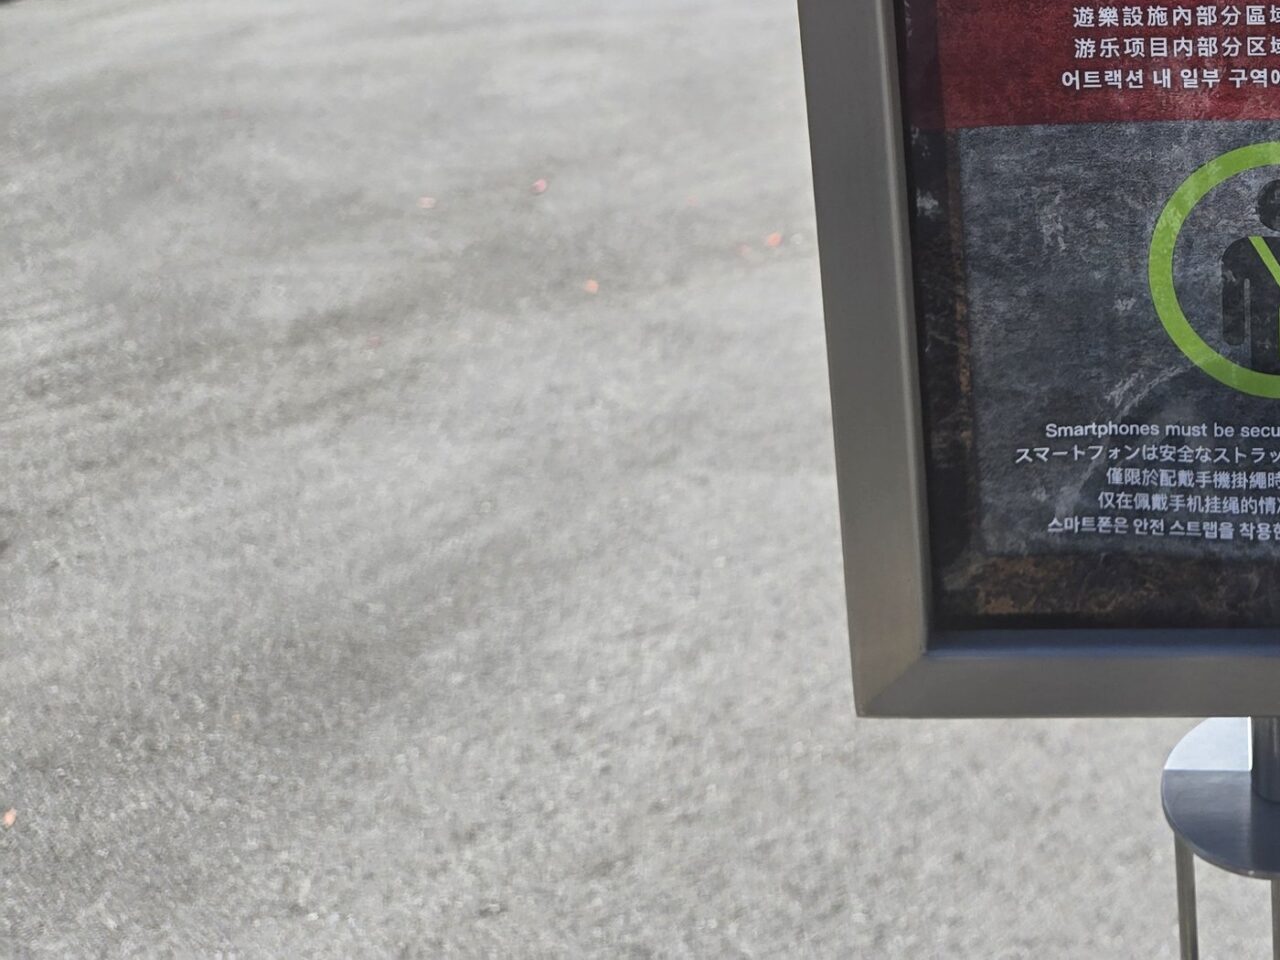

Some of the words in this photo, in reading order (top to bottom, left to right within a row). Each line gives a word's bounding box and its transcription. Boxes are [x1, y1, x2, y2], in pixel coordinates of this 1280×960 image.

[1061, 70, 1144, 90] 어트랙션
[1153, 69, 1172, 88] 내
[1180, 69, 1221, 88] 일부
[1045, 421, 1160, 439] Smartphones
[1165, 423, 1208, 437] must
[1214, 423, 1235, 438] be
[1047, 516, 1130, 534] 스마트폰은
[1133, 517, 1165, 536] 안전
[1169, 518, 1235, 540] 스트랩을
